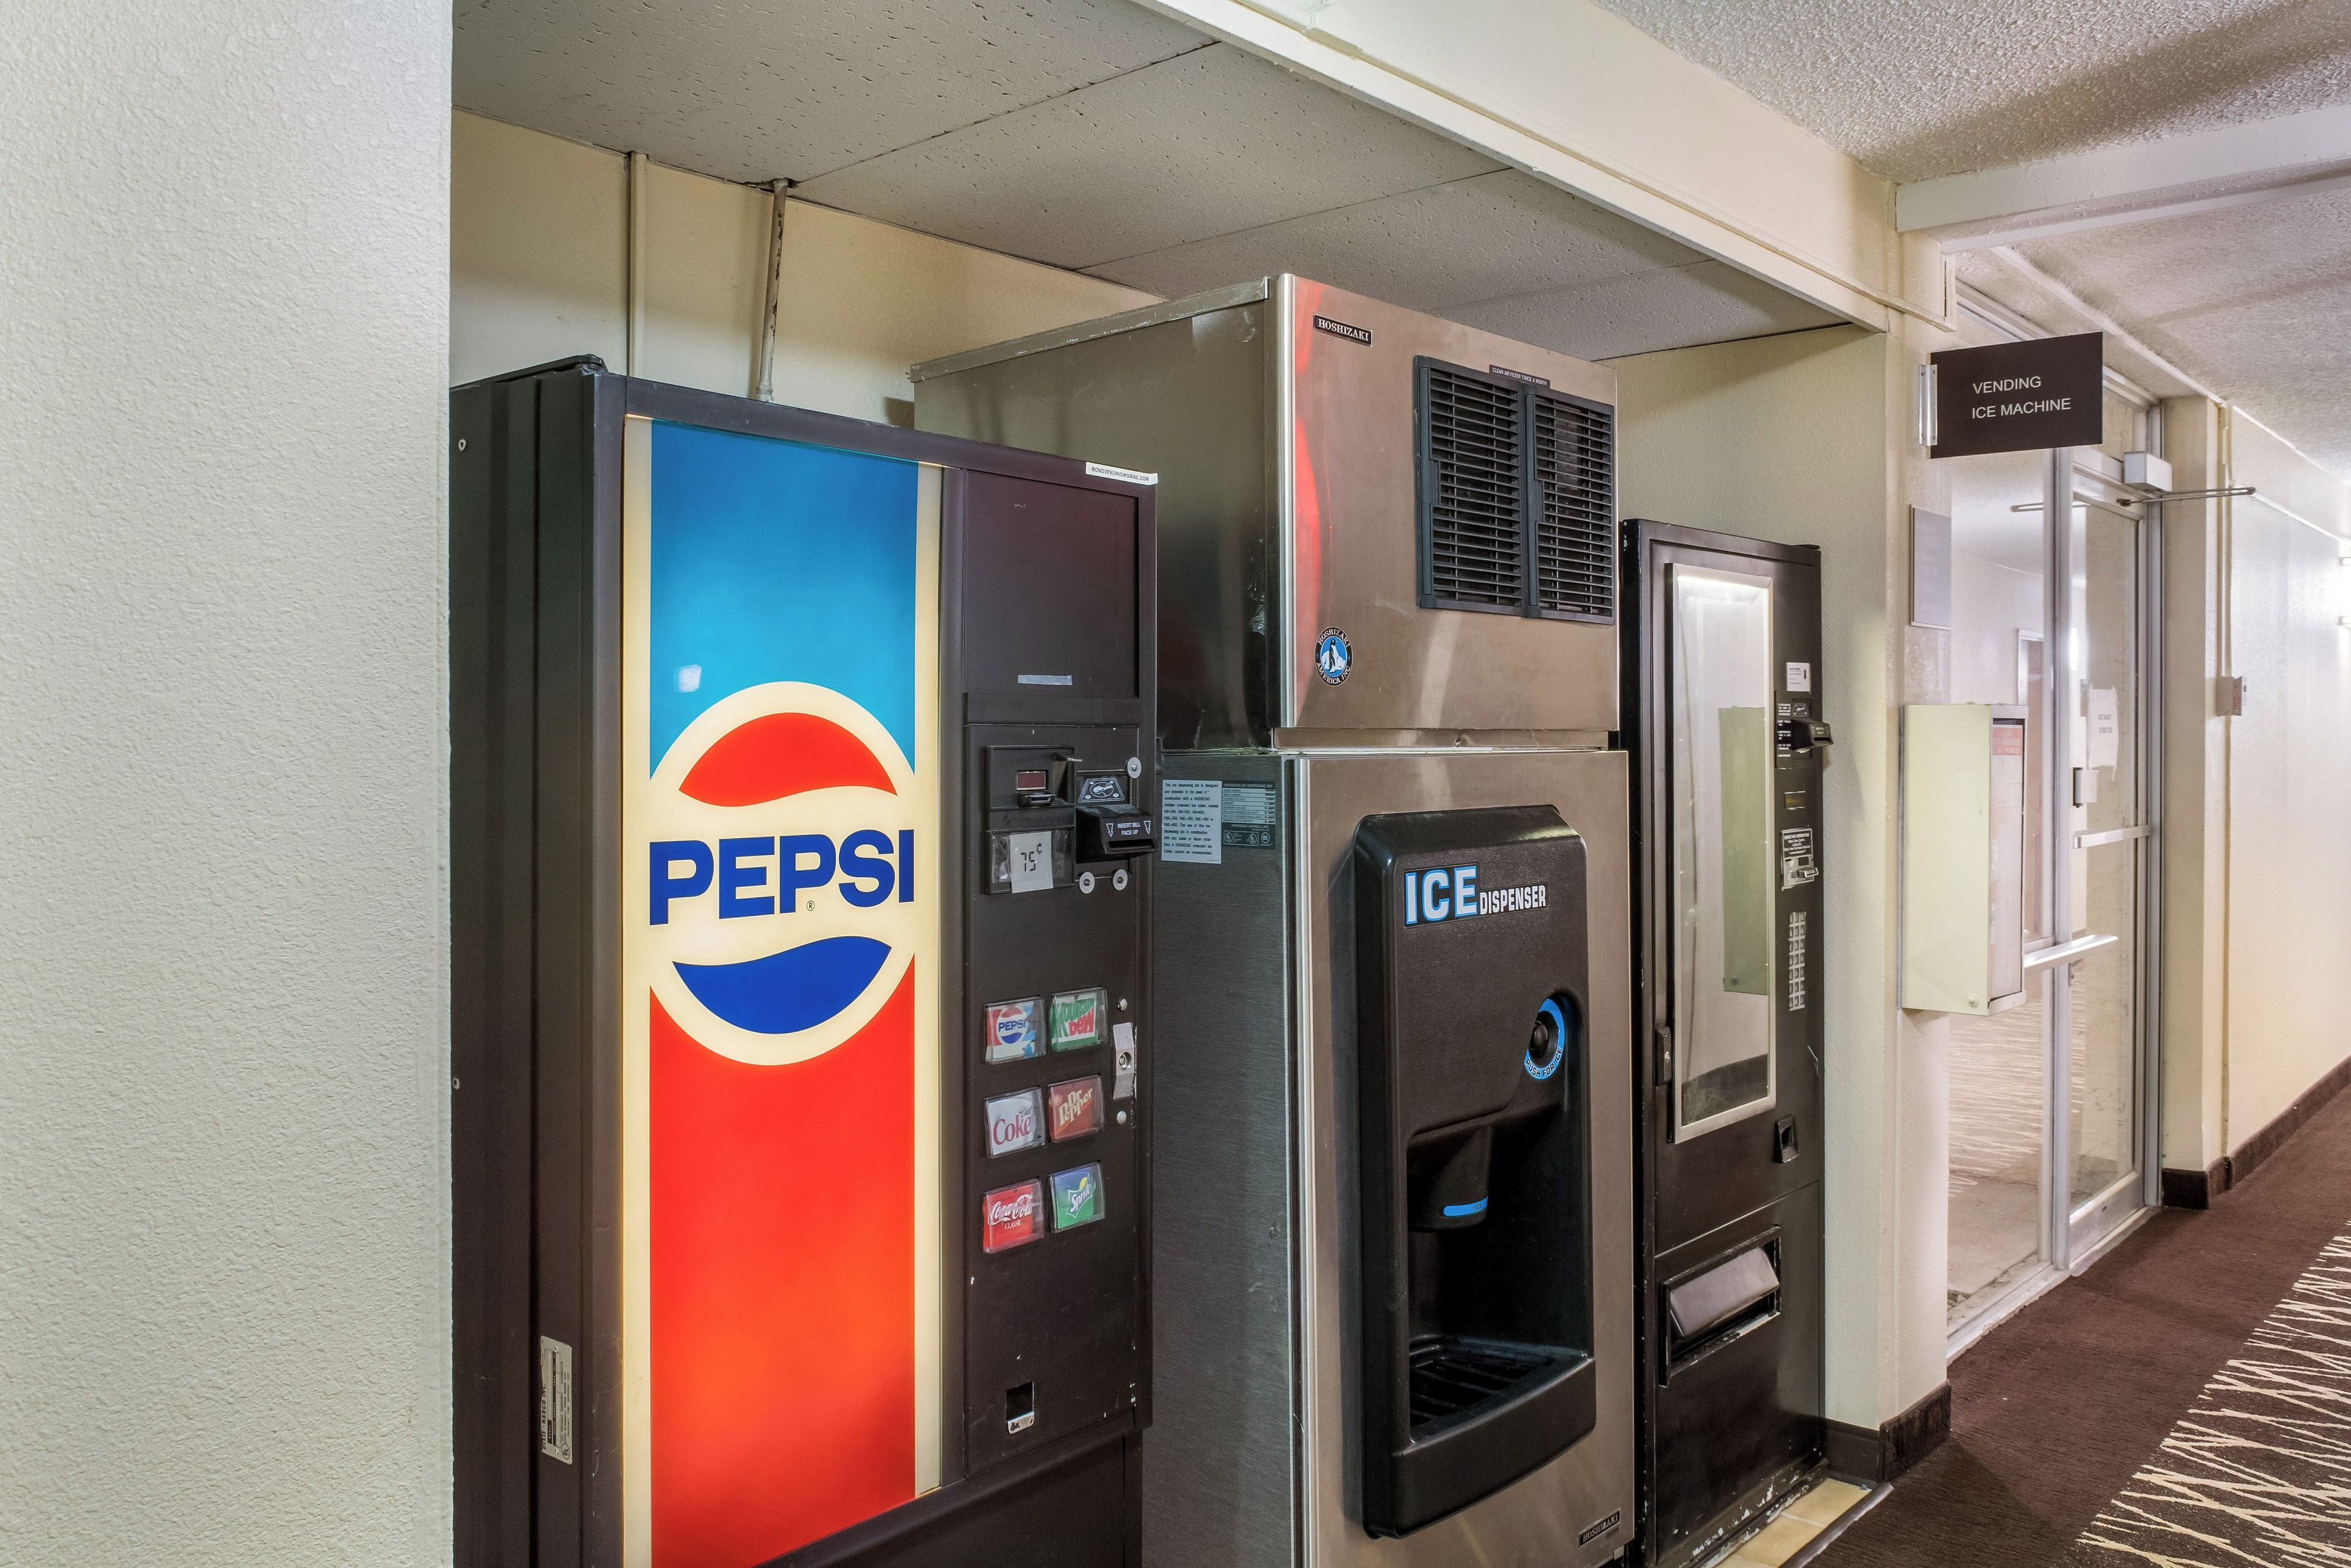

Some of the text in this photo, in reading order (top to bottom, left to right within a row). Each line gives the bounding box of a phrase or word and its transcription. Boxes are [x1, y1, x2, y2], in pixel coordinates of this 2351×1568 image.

[1318, 318, 1369, 342] HOSHIZAKI
[1973, 376, 2041, 394] VENDING
[1972, 398, 2071, 419] ICE MACHINE
[1092, 467, 1149, 482] BONDVENDING@GMAIL.COM
[1318, 629, 1350, 647] HOSHIZAKI
[650, 829, 915, 926] PEPSI
[1405, 866, 1546, 925] ICE DISPENSER
[999, 1019, 1026, 1032] PEPSI
[1526, 1058, 1541, 1078] PUSH
[1543, 1063, 1554, 1077] FOR
[1058, 1088, 1093, 1127] Pepper
[1068, 1089, 1082, 1108] Dr
[1019, 1106, 1032, 1119] Diet
[993, 1114, 1031, 1145] Coke
[1070, 1184, 1091, 1213] Sprite
[1005, 1221, 1022, 1230] CLASSIC
[1583, 1513, 1618, 1542] HOSHIZAKI
